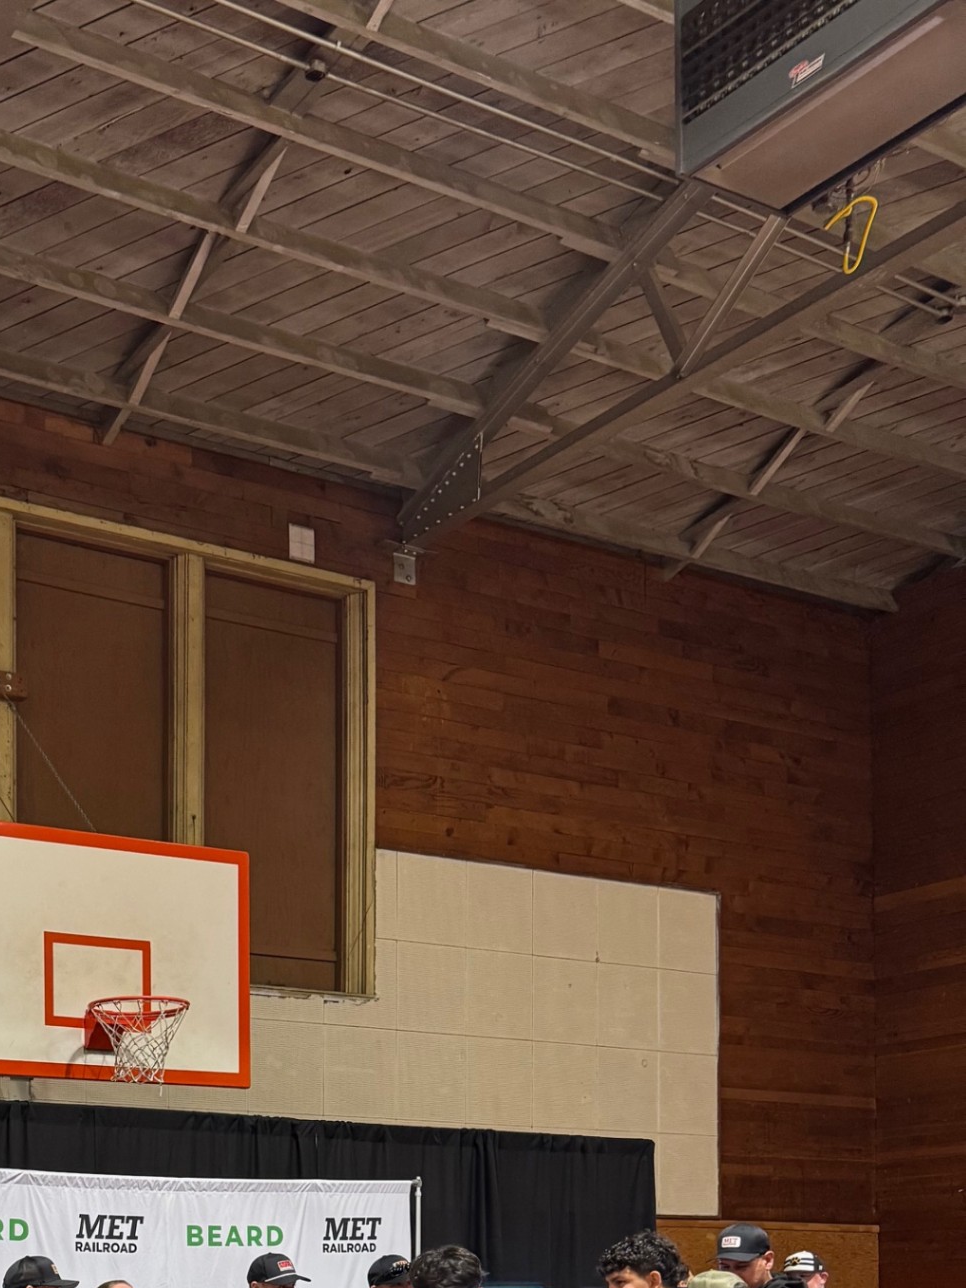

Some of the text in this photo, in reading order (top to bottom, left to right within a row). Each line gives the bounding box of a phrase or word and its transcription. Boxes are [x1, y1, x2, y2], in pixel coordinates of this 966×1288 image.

[76, 1214, 144, 1240] MET
[186, 1225, 284, 1247] BEARD
[323, 1217, 382, 1241] MET
[75, 1241, 137, 1254] RAILROAD
[322, 1243, 377, 1254] RAILROAD
